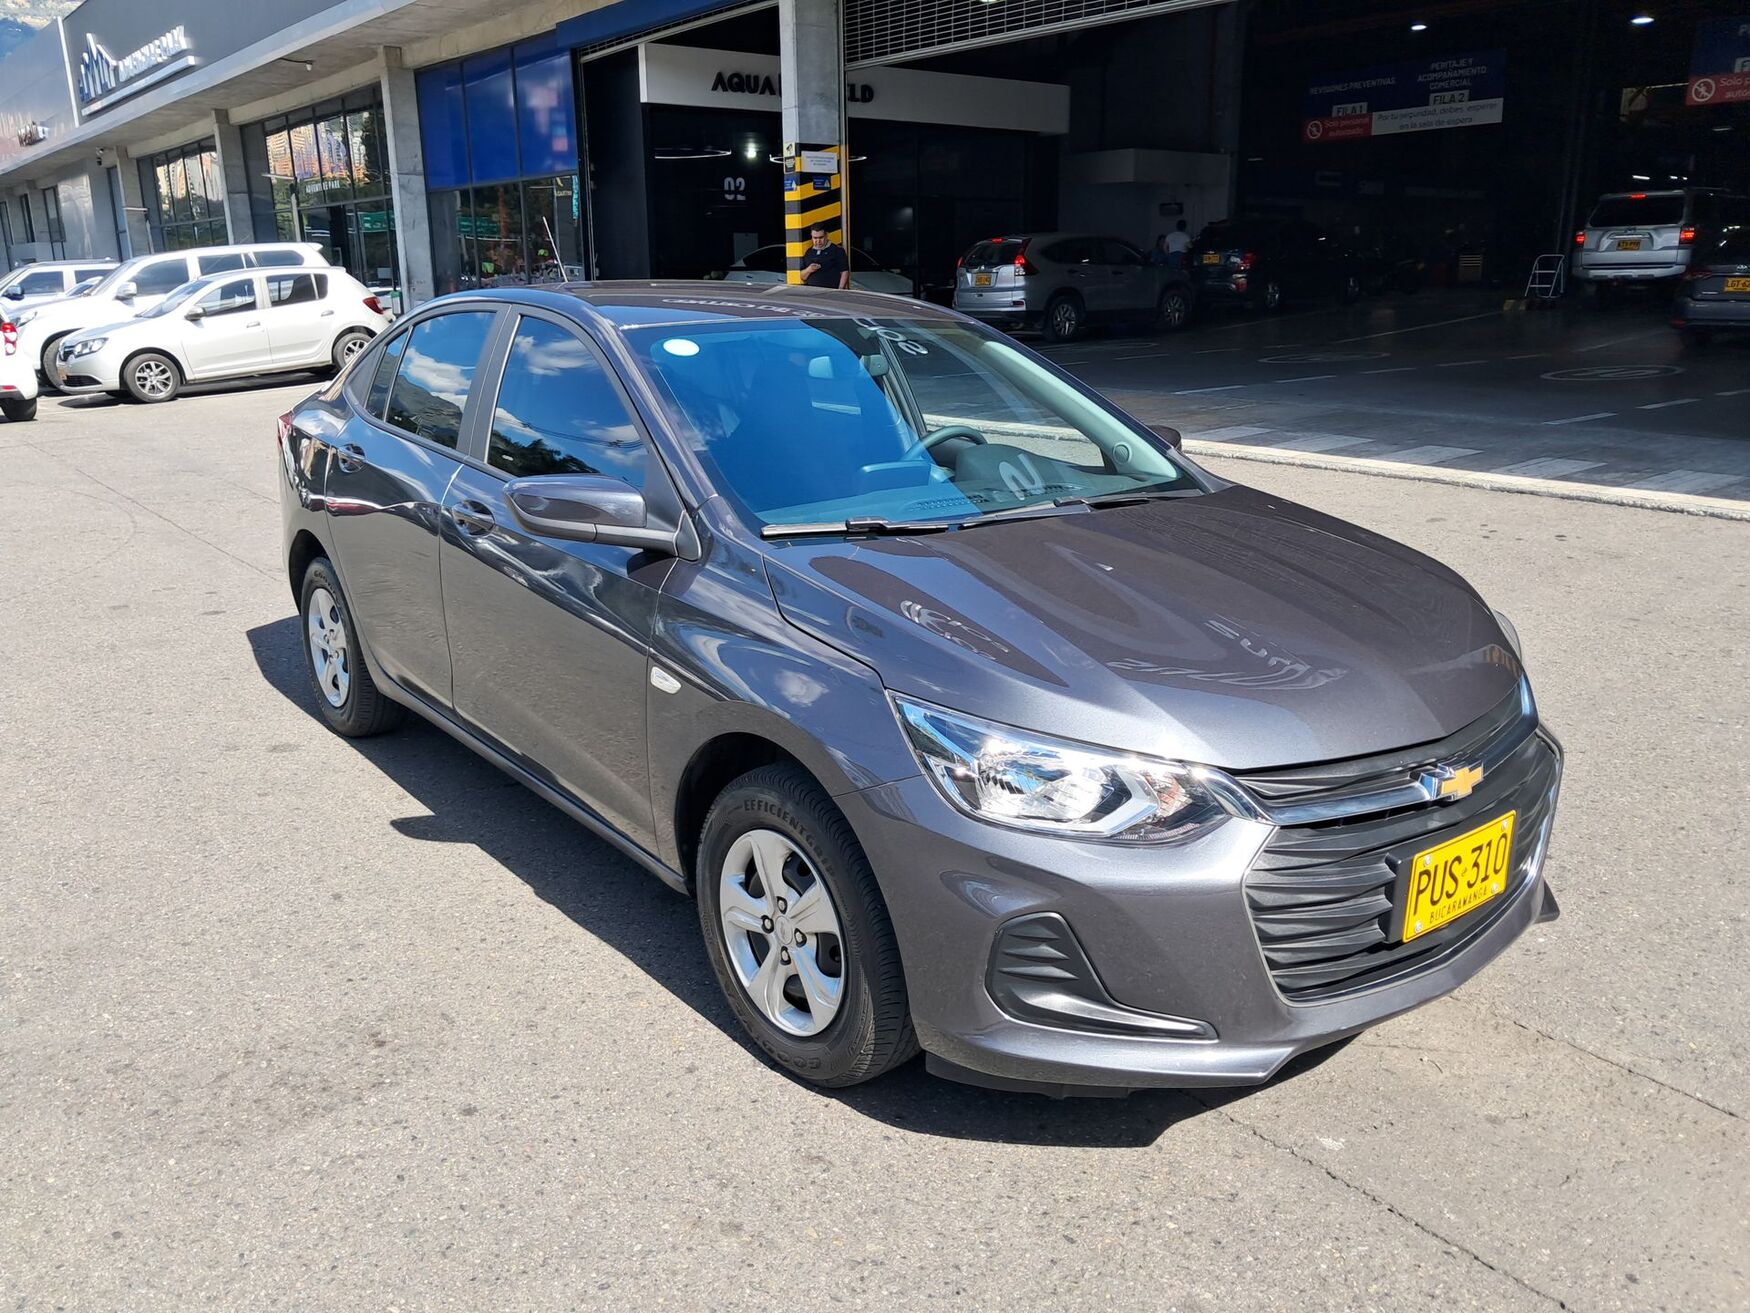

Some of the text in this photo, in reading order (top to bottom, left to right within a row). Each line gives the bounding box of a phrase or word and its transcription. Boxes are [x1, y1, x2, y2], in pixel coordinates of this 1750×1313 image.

[711, 71, 777, 95] AQUA
[1433, 92, 1466, 106] FILA 2
[723, 176, 747, 201] 02
